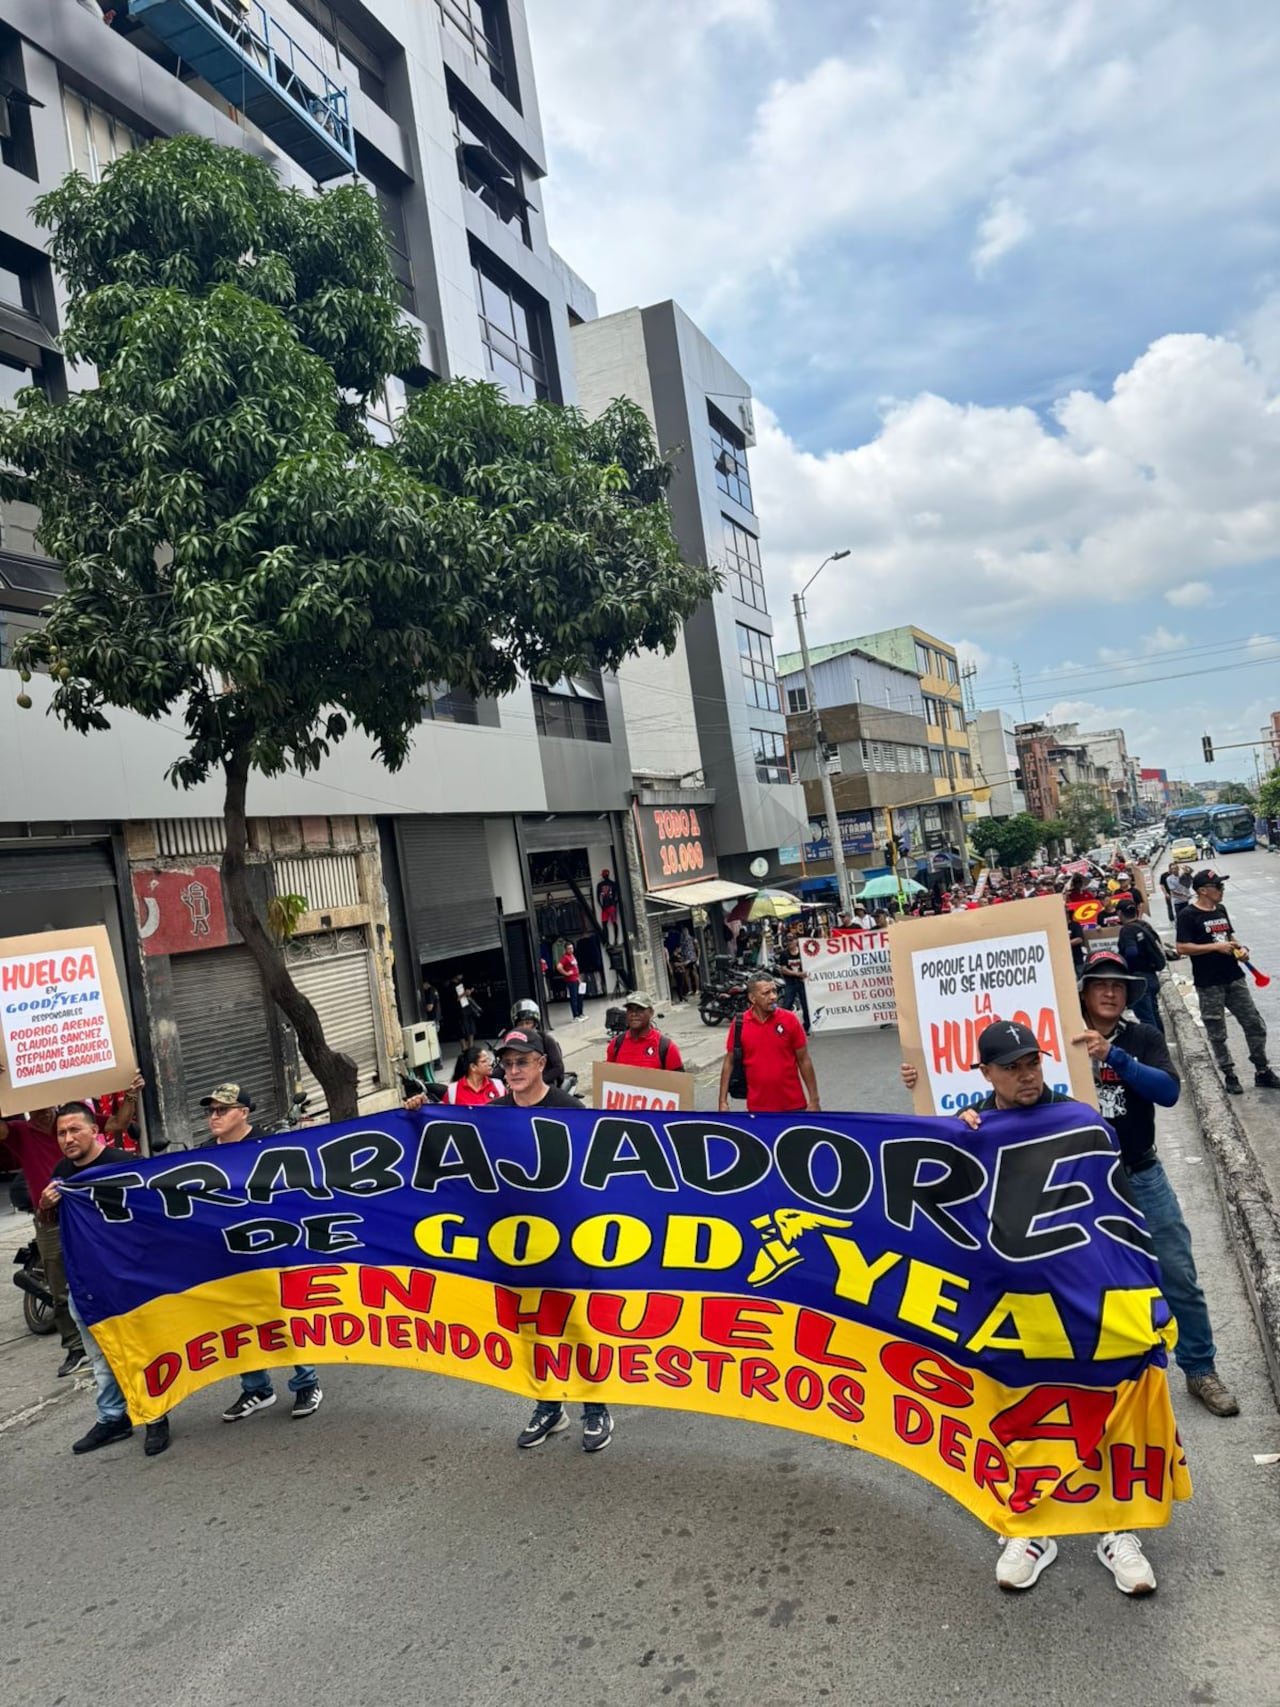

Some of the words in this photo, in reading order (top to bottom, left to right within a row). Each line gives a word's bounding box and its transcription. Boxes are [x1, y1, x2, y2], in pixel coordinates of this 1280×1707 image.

[654, 809, 689, 839] TODO
[689, 808, 700, 837] A
[660, 841, 704, 875] 10.000
[2, 954, 95, 992] HUELGA
[921, 956, 965, 980] PORQUE
[969, 953, 983, 972] LA
[986, 944, 1045, 970] DIGNIDAD
[45, 985, 58, 995] EN
[828, 982, 843, 992] DE
[844, 980, 859, 990] LA
[939, 980, 956, 996] NO
[961, 974, 976, 993] SE
[980, 965, 1037, 991] NEGOCIA
[852, 990, 868, 1000] DE
[975, 992, 992, 1014] LA
[31, 1007, 83, 1023] RESPONSABLES
[826, 1006, 853, 1016] FUERA
[854, 1003, 870, 1012] LOS
[10, 1023, 58, 1042] RODRIGO
[62, 1015, 104, 1033] ARENAS
[17, 1036, 58, 1053] CLAUDIA
[60, 1028, 102, 1045] SANCHEZ
[15, 1047, 64, 1067] STEPHANIE
[67, 1038, 109, 1056] BAQUERO
[16, 1061, 57, 1079] OSWALDO
[221, 1212, 365, 1255] DE
[413, 1212, 744, 1270] GOOD
[143, 1311, 513, 1399] DEFENDIENDO
[534, 1342, 866, 1424] NUESTROS
[279, 1265, 436, 1314] EN
[495, 1284, 1117, 1461] HUELGA
